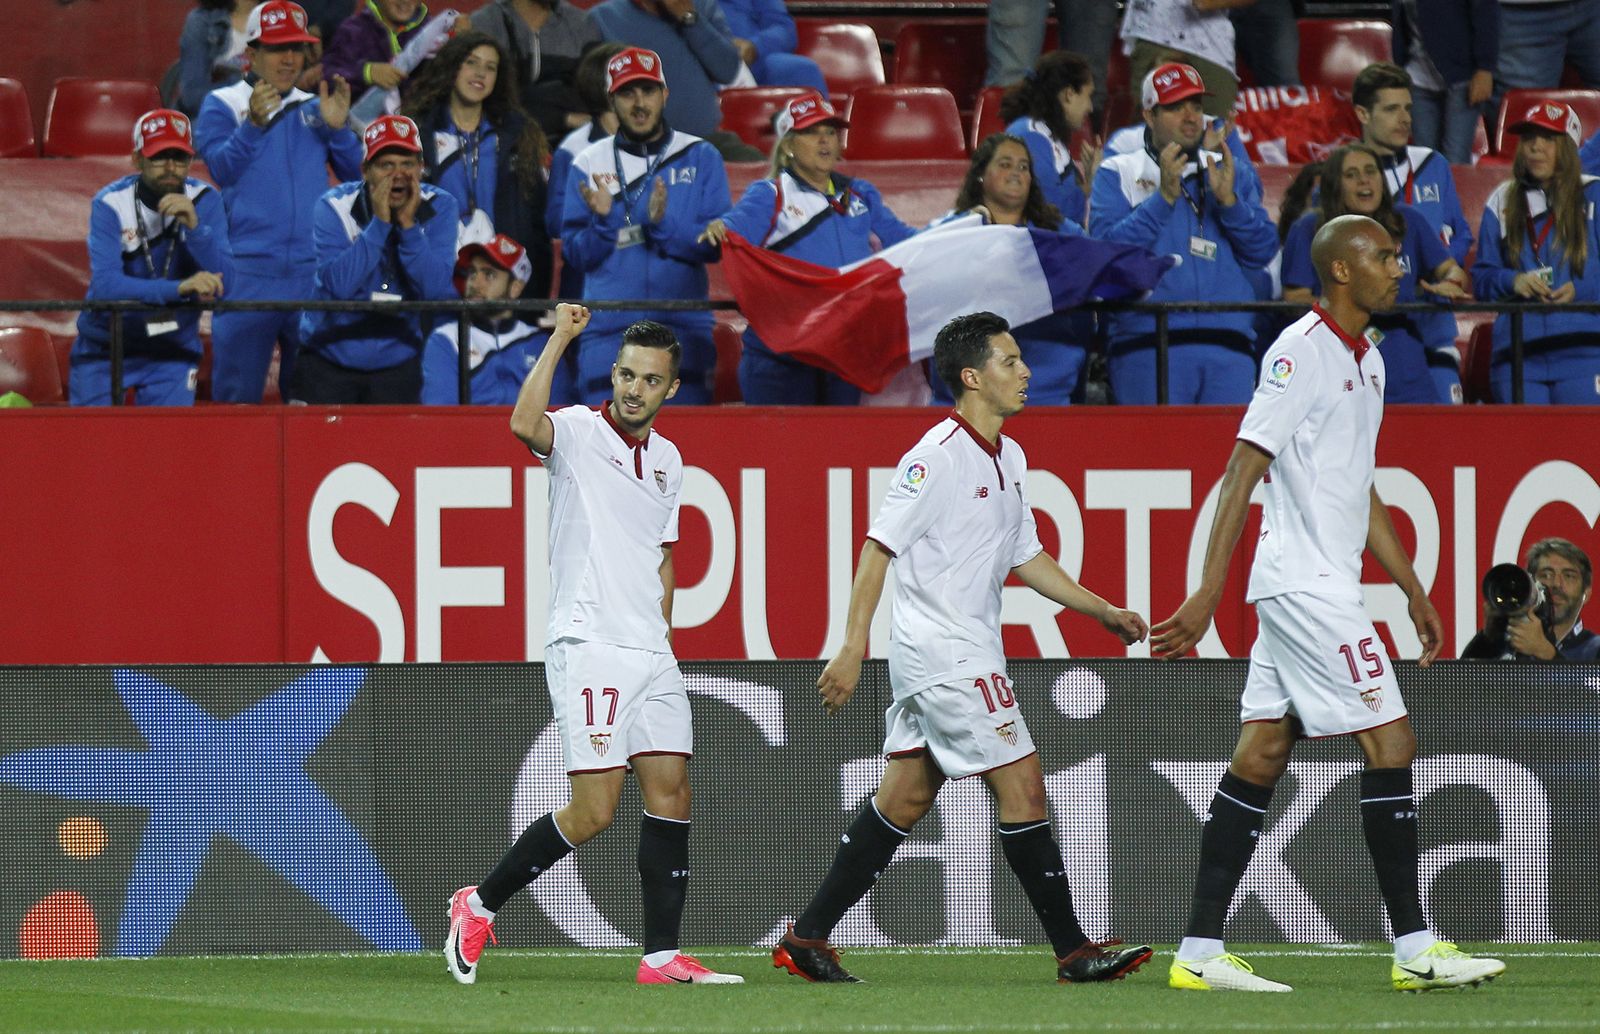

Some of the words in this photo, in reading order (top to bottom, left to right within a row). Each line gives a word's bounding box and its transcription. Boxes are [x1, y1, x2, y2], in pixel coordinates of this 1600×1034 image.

[1338, 636, 1384, 684] 15
[580, 687, 620, 726] 17
[974, 672, 1015, 714] 10
